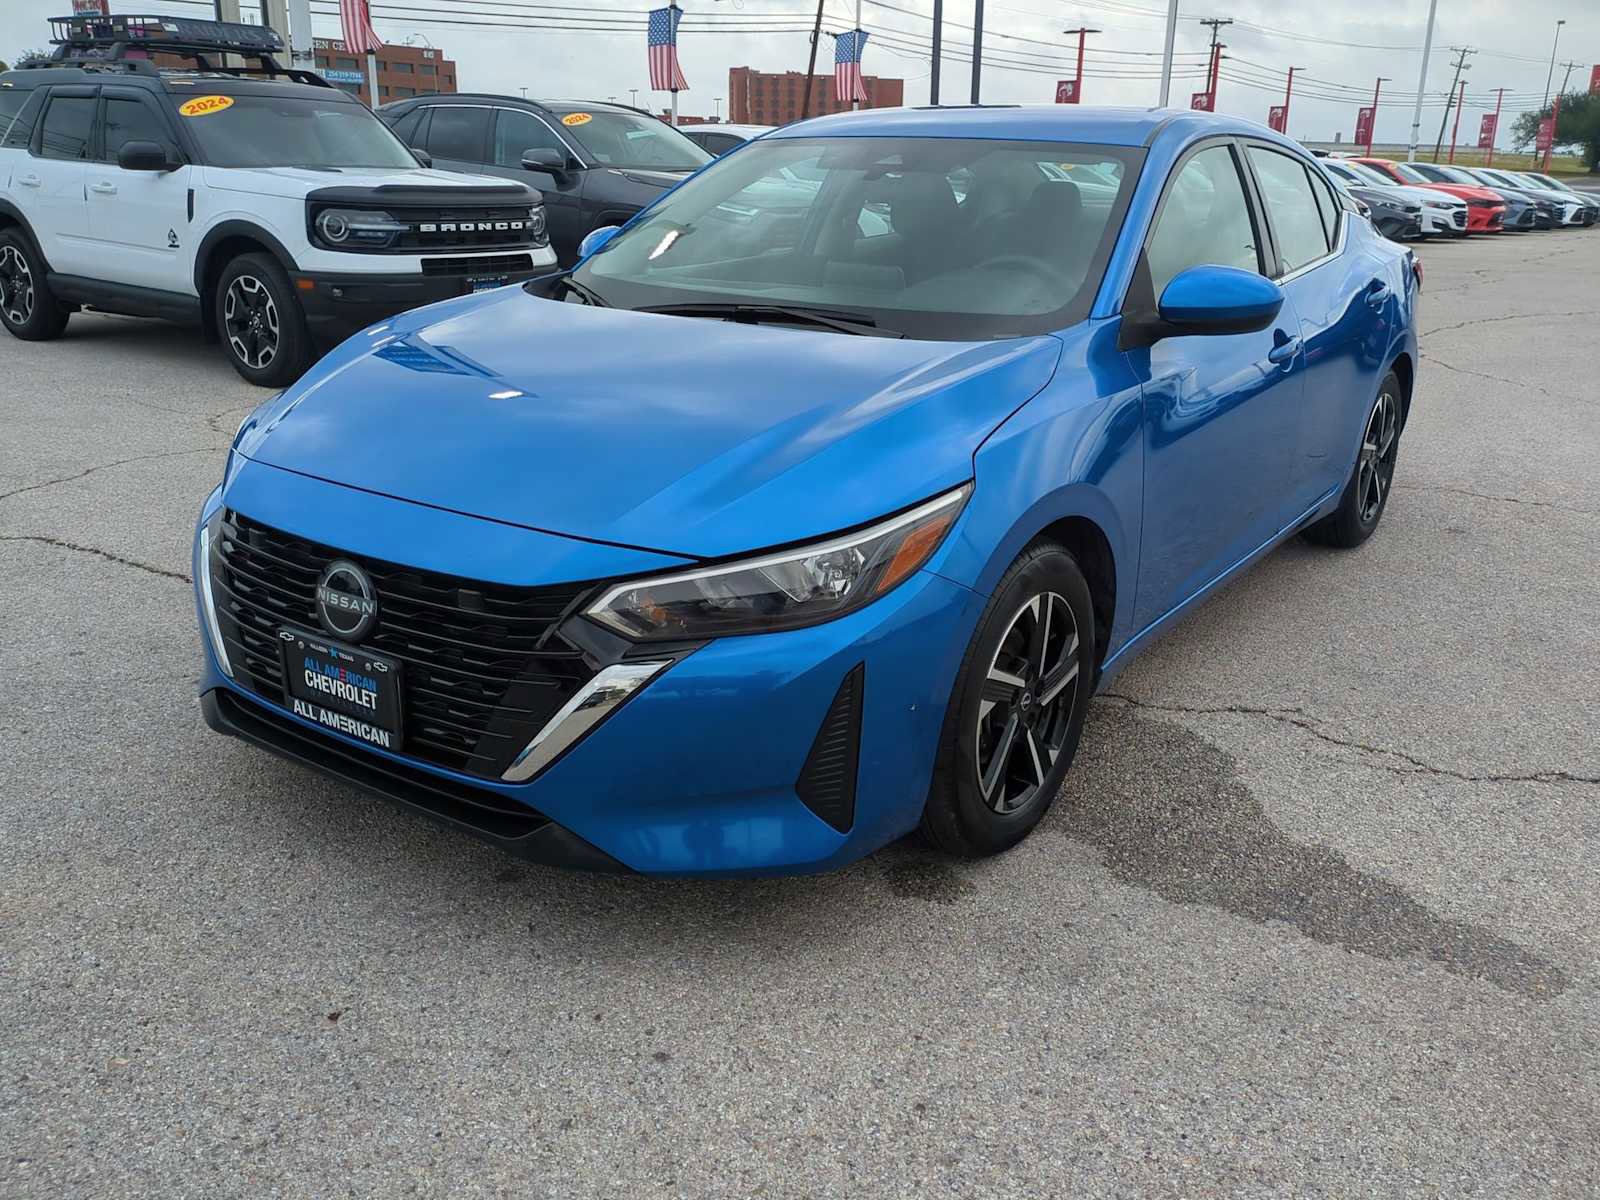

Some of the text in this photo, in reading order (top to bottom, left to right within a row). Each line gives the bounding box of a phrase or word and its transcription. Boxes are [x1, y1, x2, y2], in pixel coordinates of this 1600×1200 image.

[186, 96, 230, 115] 2024
[419, 221, 524, 233] BRONCO
[318, 587, 374, 614] NISSAN
[304, 657, 377, 692] ALL AMERICAN
[304, 669, 377, 710] CHEVROLET
[293, 699, 390, 747] ALL AMERICAN
